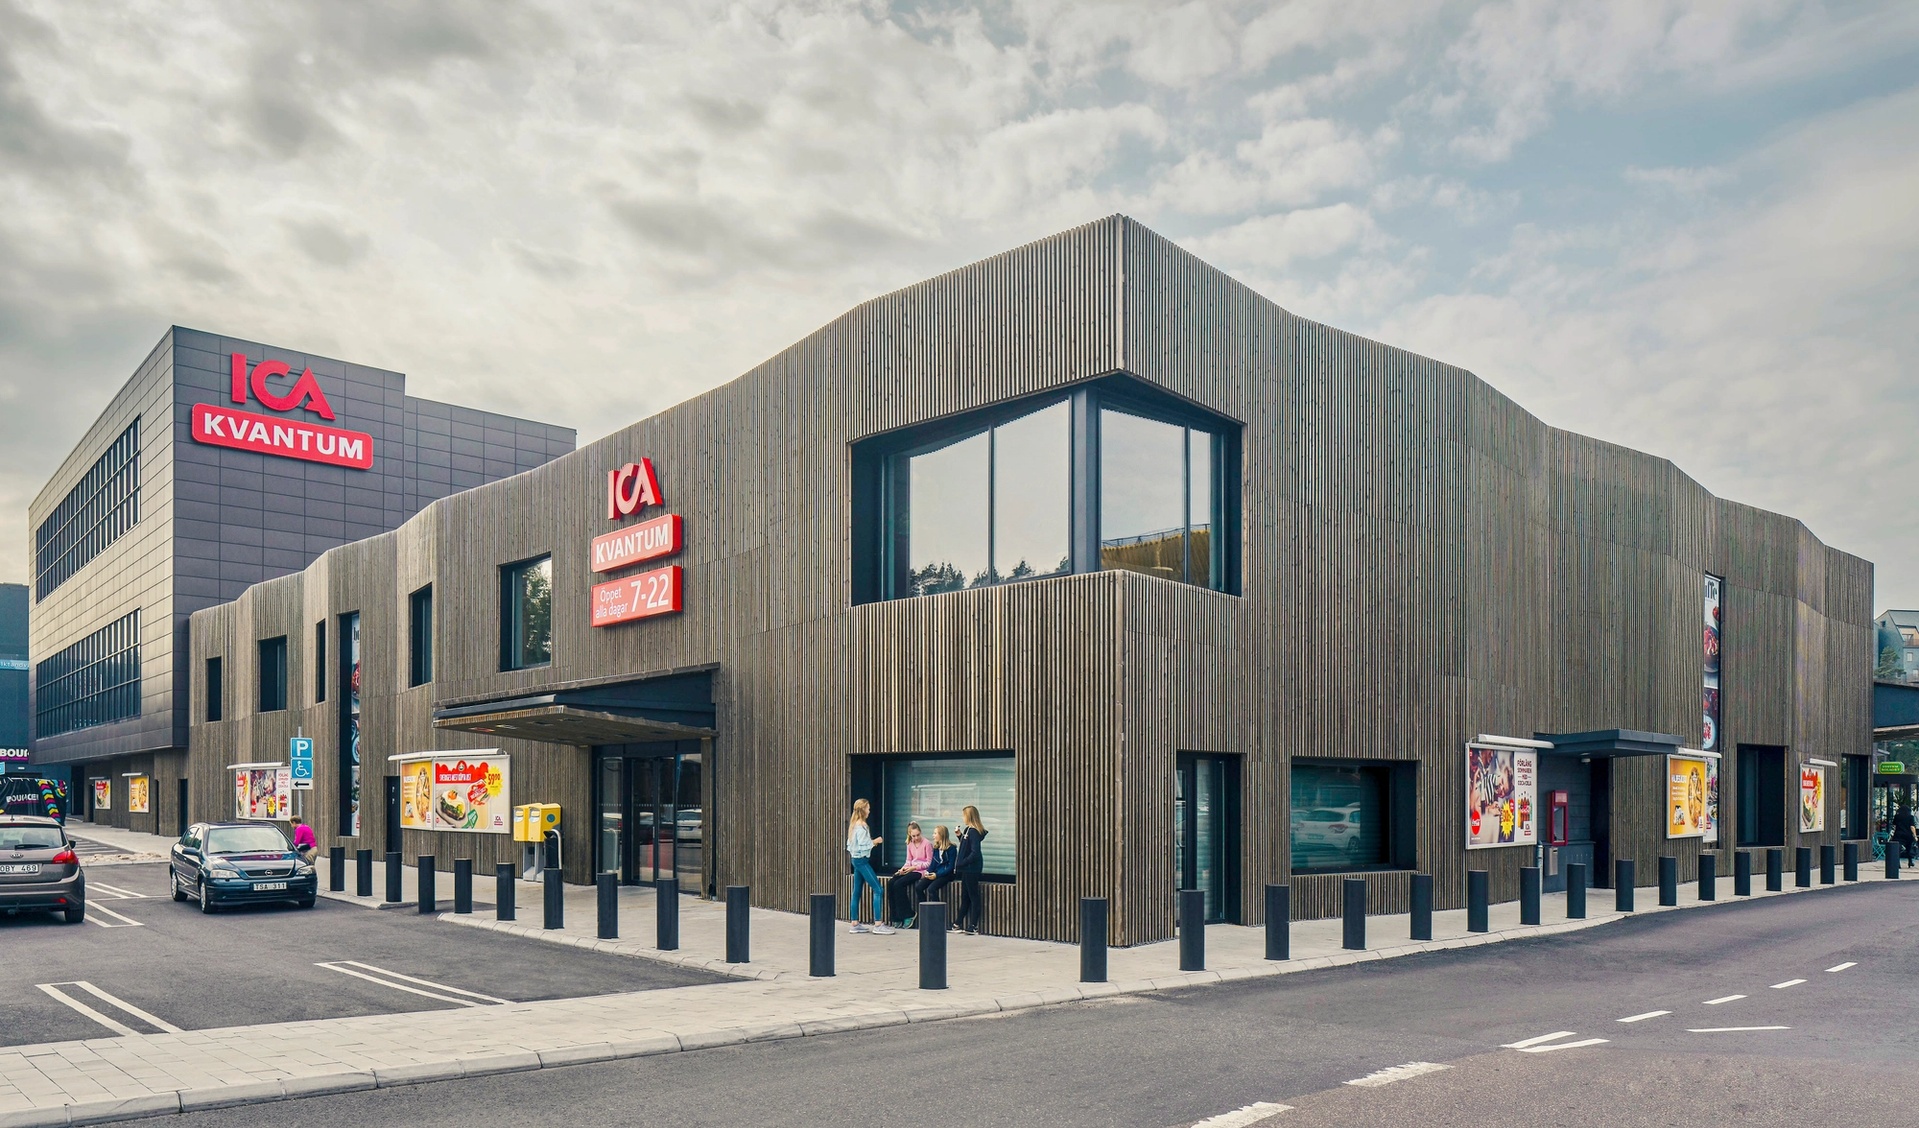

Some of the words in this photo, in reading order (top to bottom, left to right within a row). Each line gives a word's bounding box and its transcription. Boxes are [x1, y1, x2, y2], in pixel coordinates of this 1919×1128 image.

[231, 352, 336, 421] ICA
[204, 412, 363, 461] KVANTUM
[608, 457, 662, 520] ICA
[596, 523, 669, 565] KVANTUM
[595, 604, 608, 619] alla
[608, 601, 629, 618] dagar
[600, 587, 622, 603] Öppet
[630, 573, 670, 613] 7-22
[296, 740, 309, 757] P
[21, 864, 37, 872] 469
